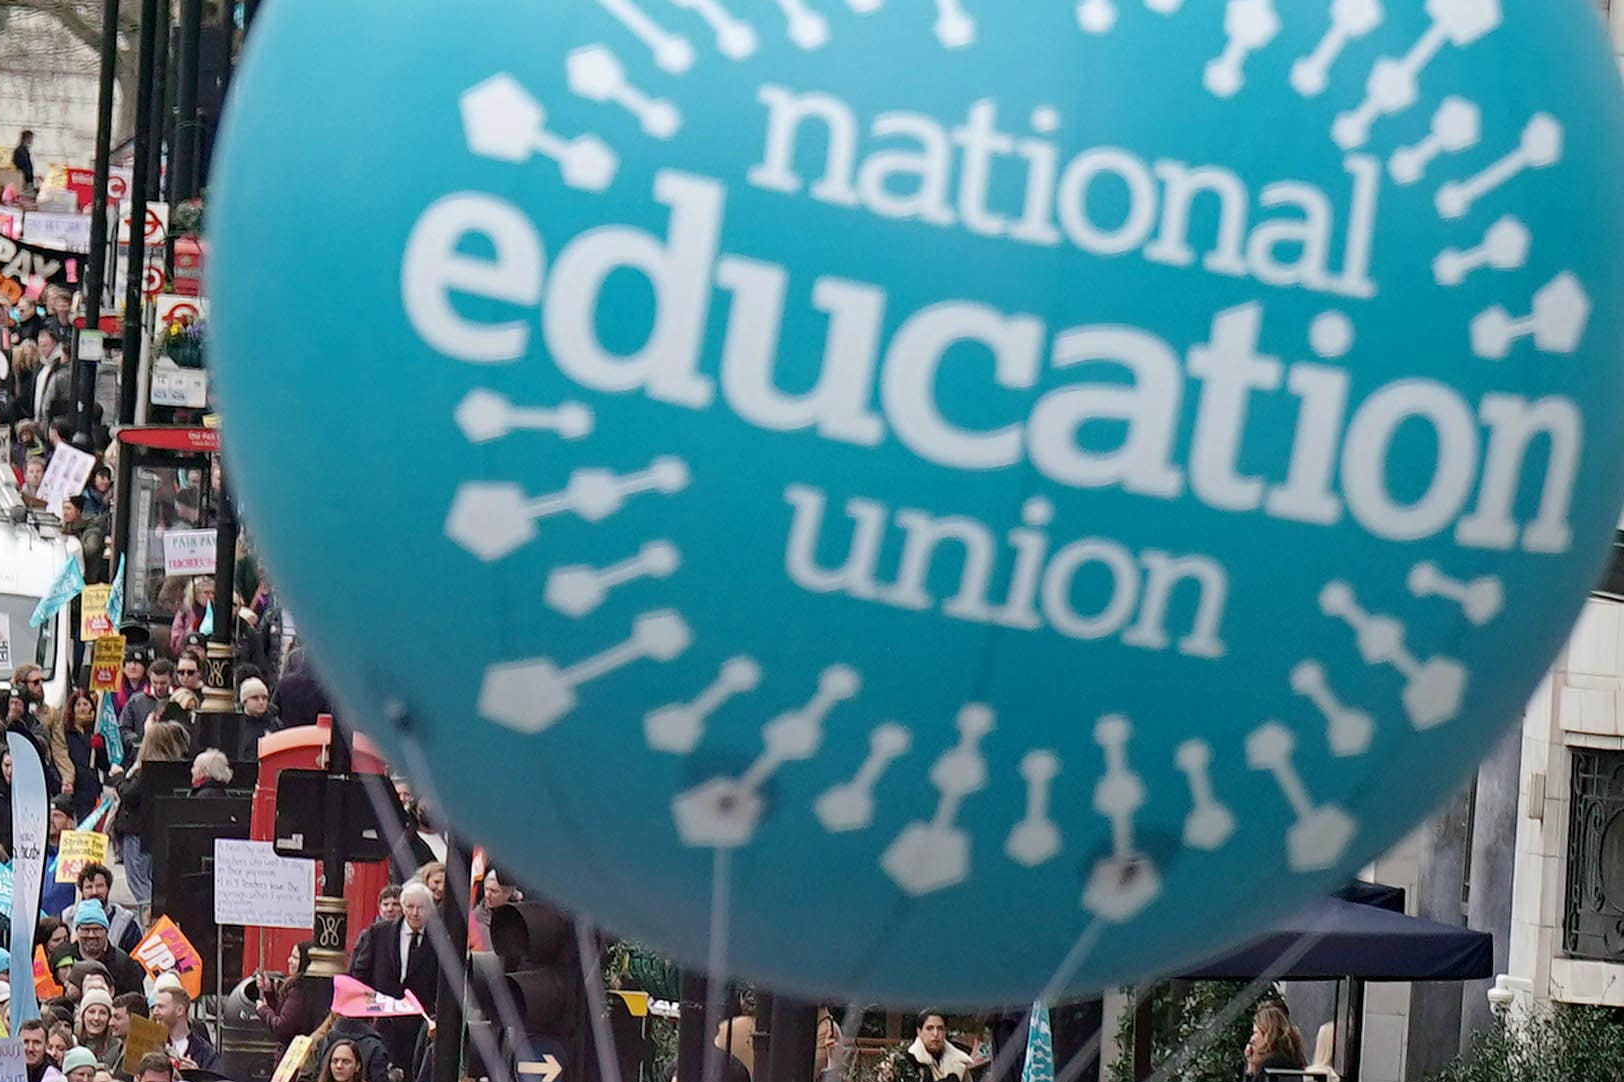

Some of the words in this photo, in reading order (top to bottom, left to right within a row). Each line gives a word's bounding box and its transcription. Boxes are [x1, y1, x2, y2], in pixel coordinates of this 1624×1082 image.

[747, 82, 1376, 297] national
[400, 168, 1585, 555] education
[784, 480, 1234, 659] union
